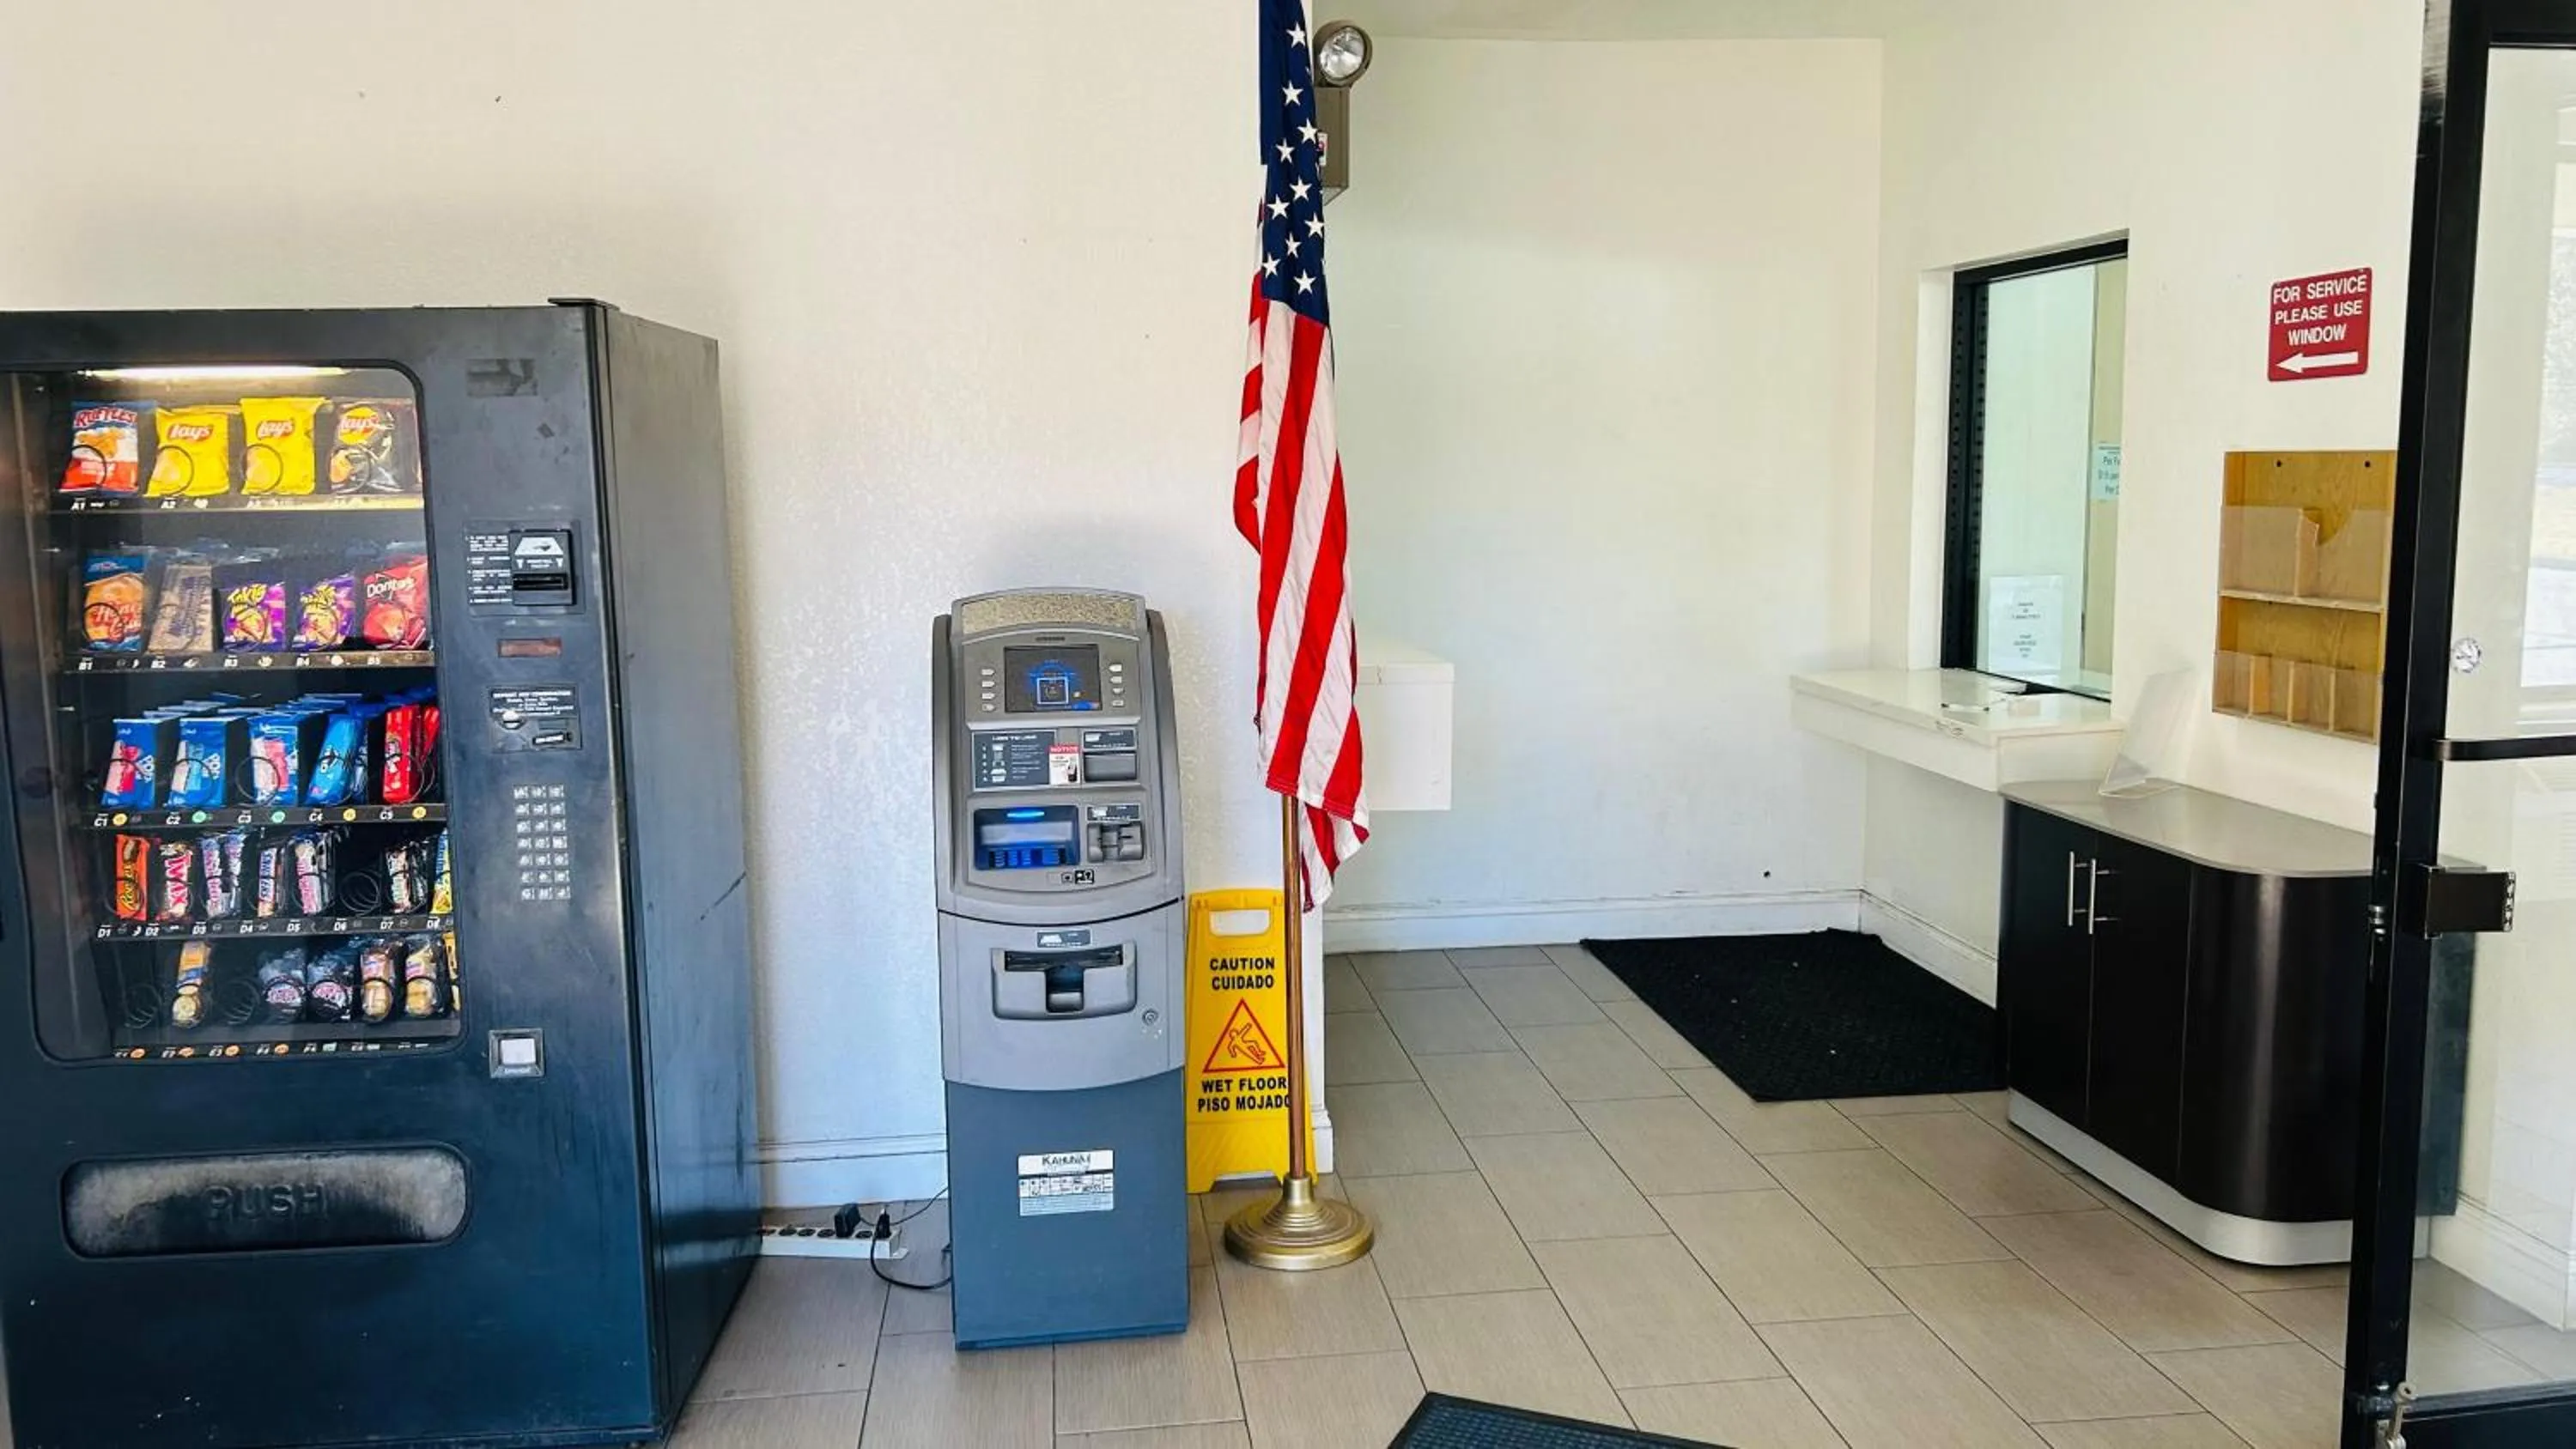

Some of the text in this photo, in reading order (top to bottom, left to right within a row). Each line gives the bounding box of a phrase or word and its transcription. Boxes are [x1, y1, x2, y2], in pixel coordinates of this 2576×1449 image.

[2273, 275, 2367, 305] FOR SERVICE
[2275, 300, 2363, 325] PLEASE USE
[2288, 324, 2347, 346] WINDOW
[94, 817, 109, 828] C1
[166, 815, 182, 826] C2
[308, 812, 324, 822] C4
[144, 926, 161, 937] D2
[286, 923, 301, 932] D5
[380, 920, 394, 930] D7
[97, 928, 112, 938] D1
[1209, 957, 1276, 972] CAUTION
[1212, 974, 1275, 991] CUIDADO
[1202, 1076, 1287, 1094] WET FLOOR
[1198, 1094, 1292, 1113] PISO MOJADO
[206, 1182, 328, 1222] PUSH
